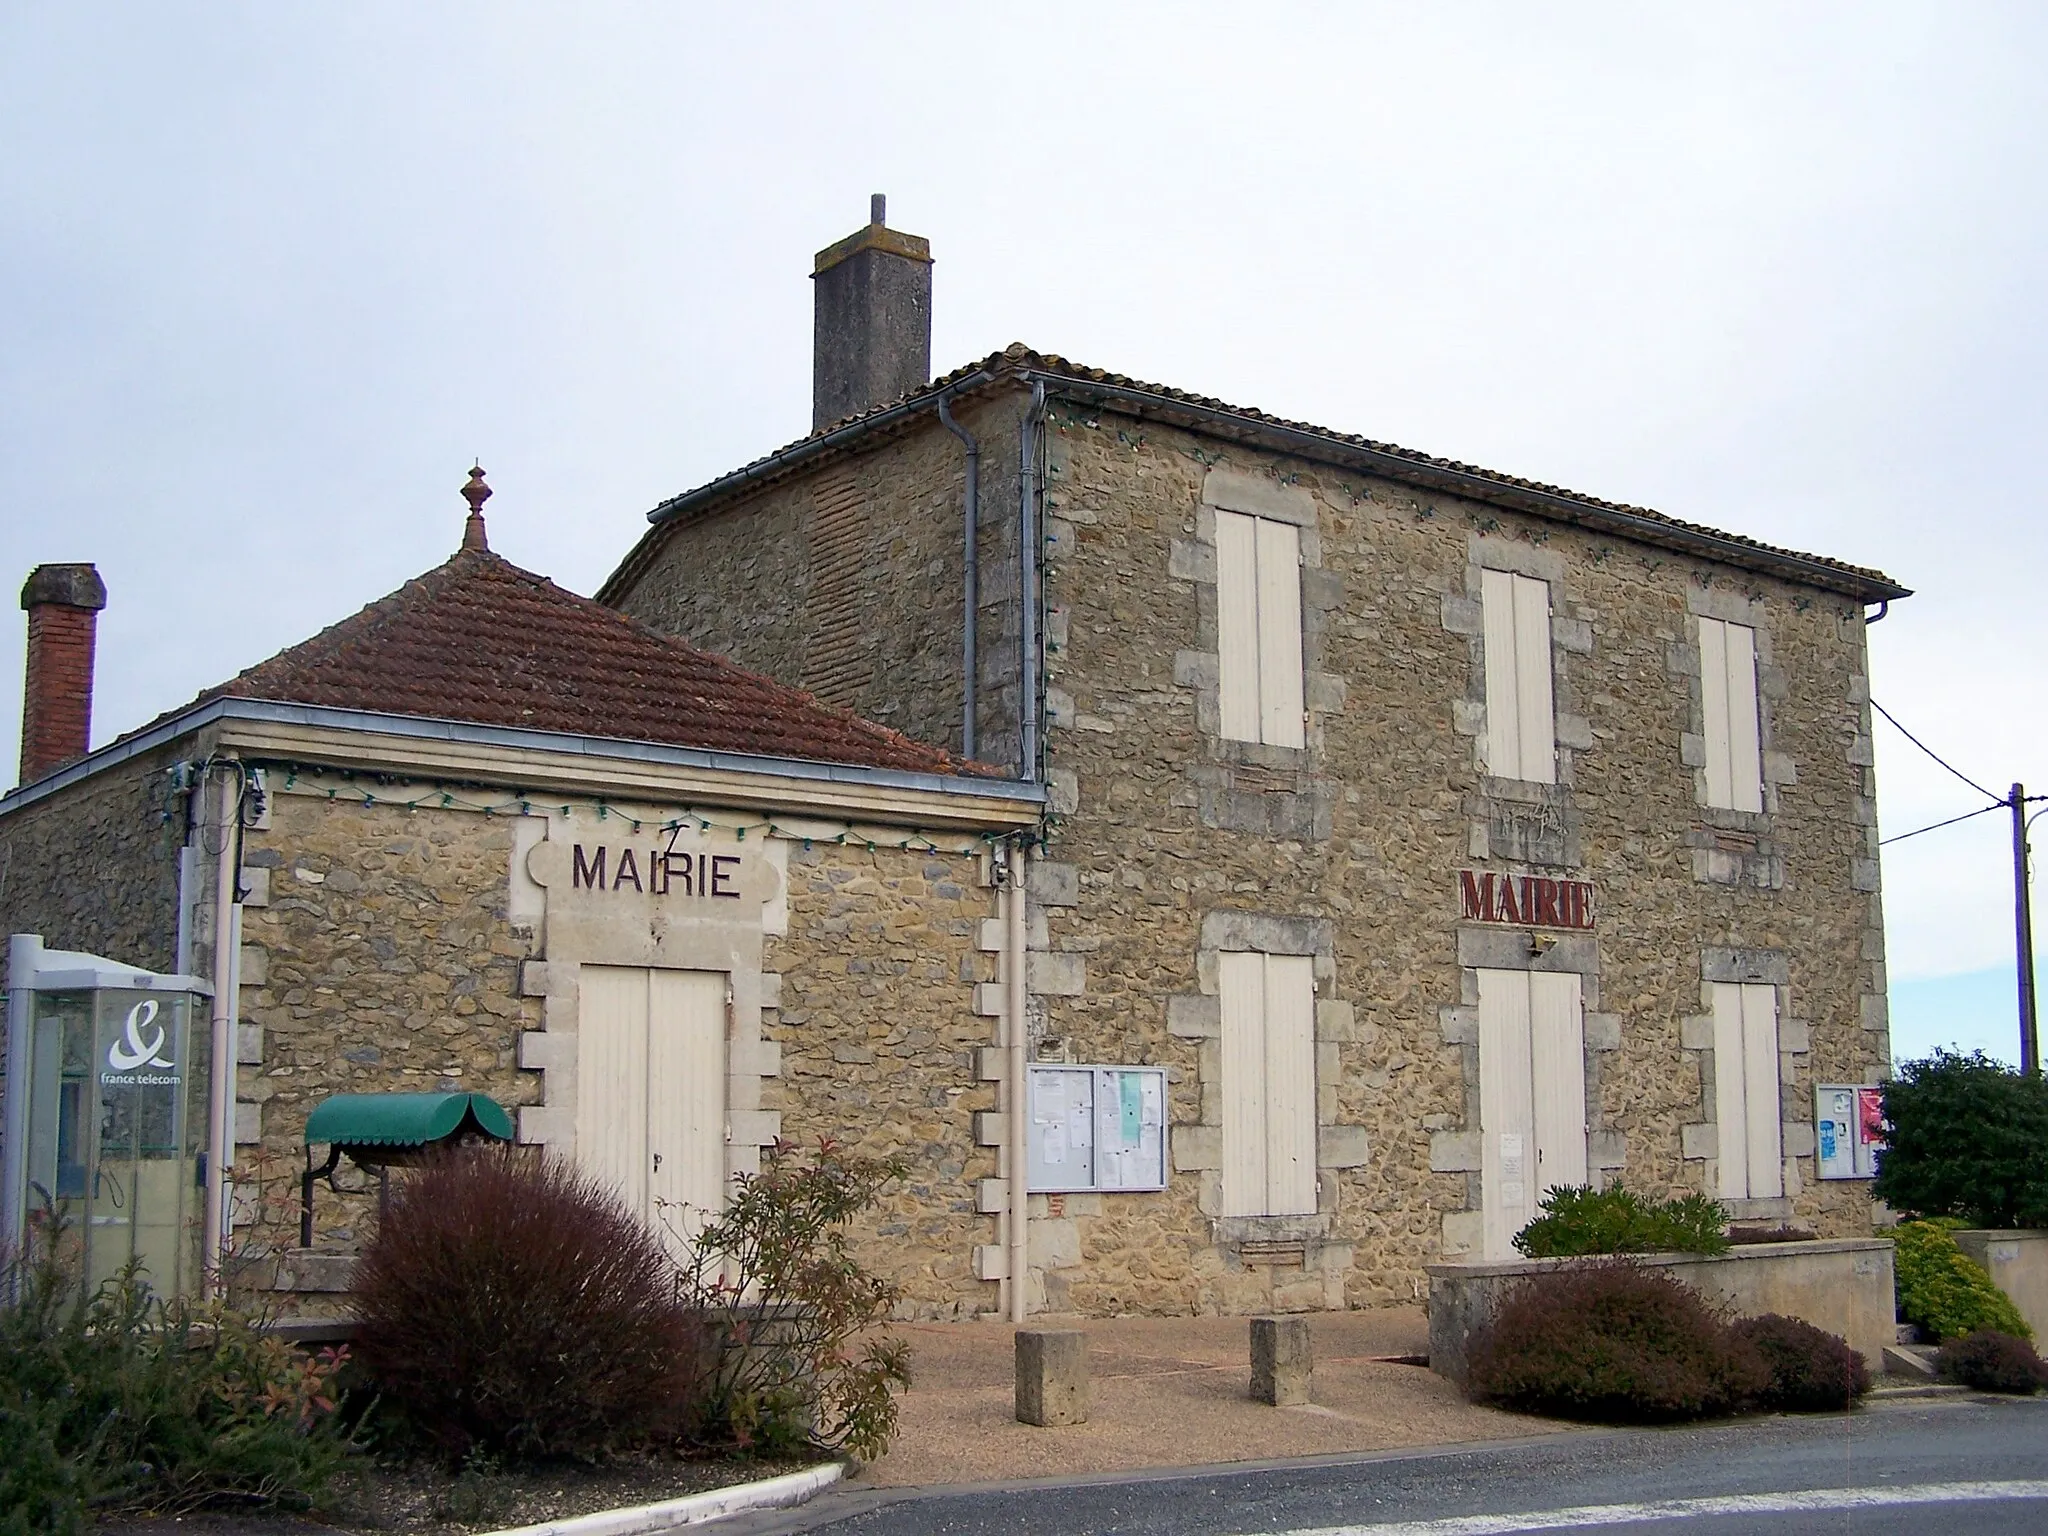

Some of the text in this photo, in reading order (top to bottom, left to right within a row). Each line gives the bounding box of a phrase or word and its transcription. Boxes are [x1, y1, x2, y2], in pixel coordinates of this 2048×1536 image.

[573, 843, 741, 899] MAIRIE
[1460, 870, 1596, 930] MAIRIE
[101, 1072, 181, 1085] france telecom
